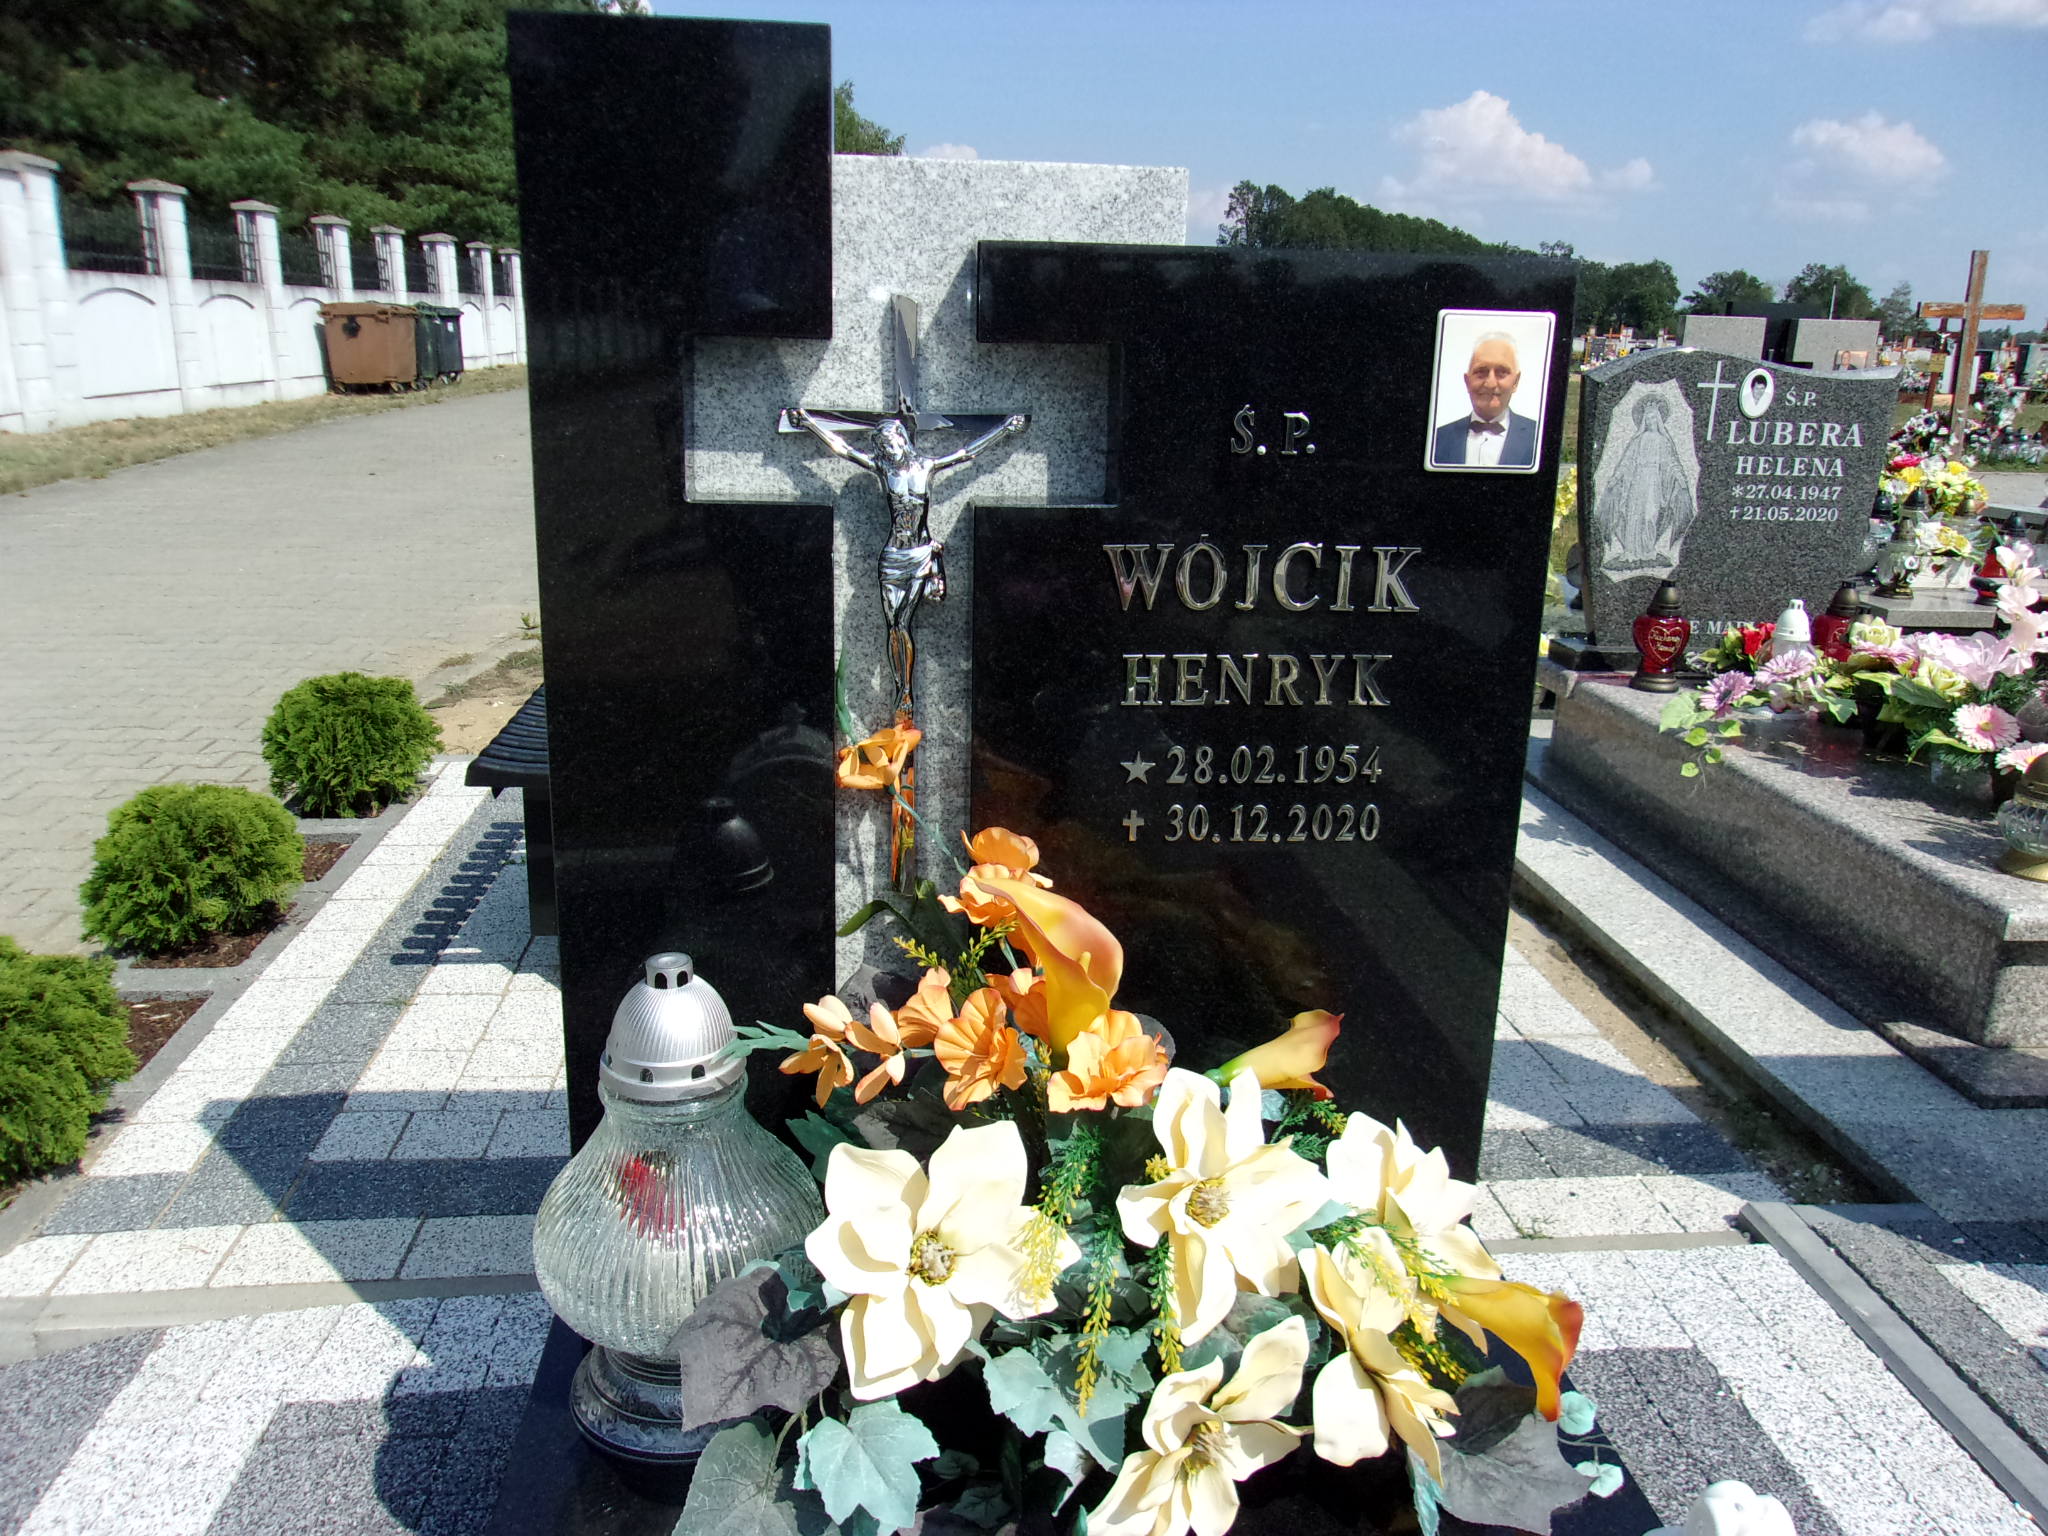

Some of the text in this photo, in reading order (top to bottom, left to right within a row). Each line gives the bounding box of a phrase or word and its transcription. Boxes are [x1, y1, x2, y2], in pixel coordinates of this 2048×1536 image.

[1727, 420, 1863, 448] LUBERA
[1735, 455, 1844, 478] HELENA
[1745, 484, 1842, 501] 27.04.1947
[1742, 505, 1839, 522] 21.05.2020
[1102, 533, 1423, 613] WÓJCIK
[1120, 653, 1393, 707] HENRYK
[1165, 744, 1383, 785] 28.02.1954
[1164, 803, 1381, 843] 30.12.2020
